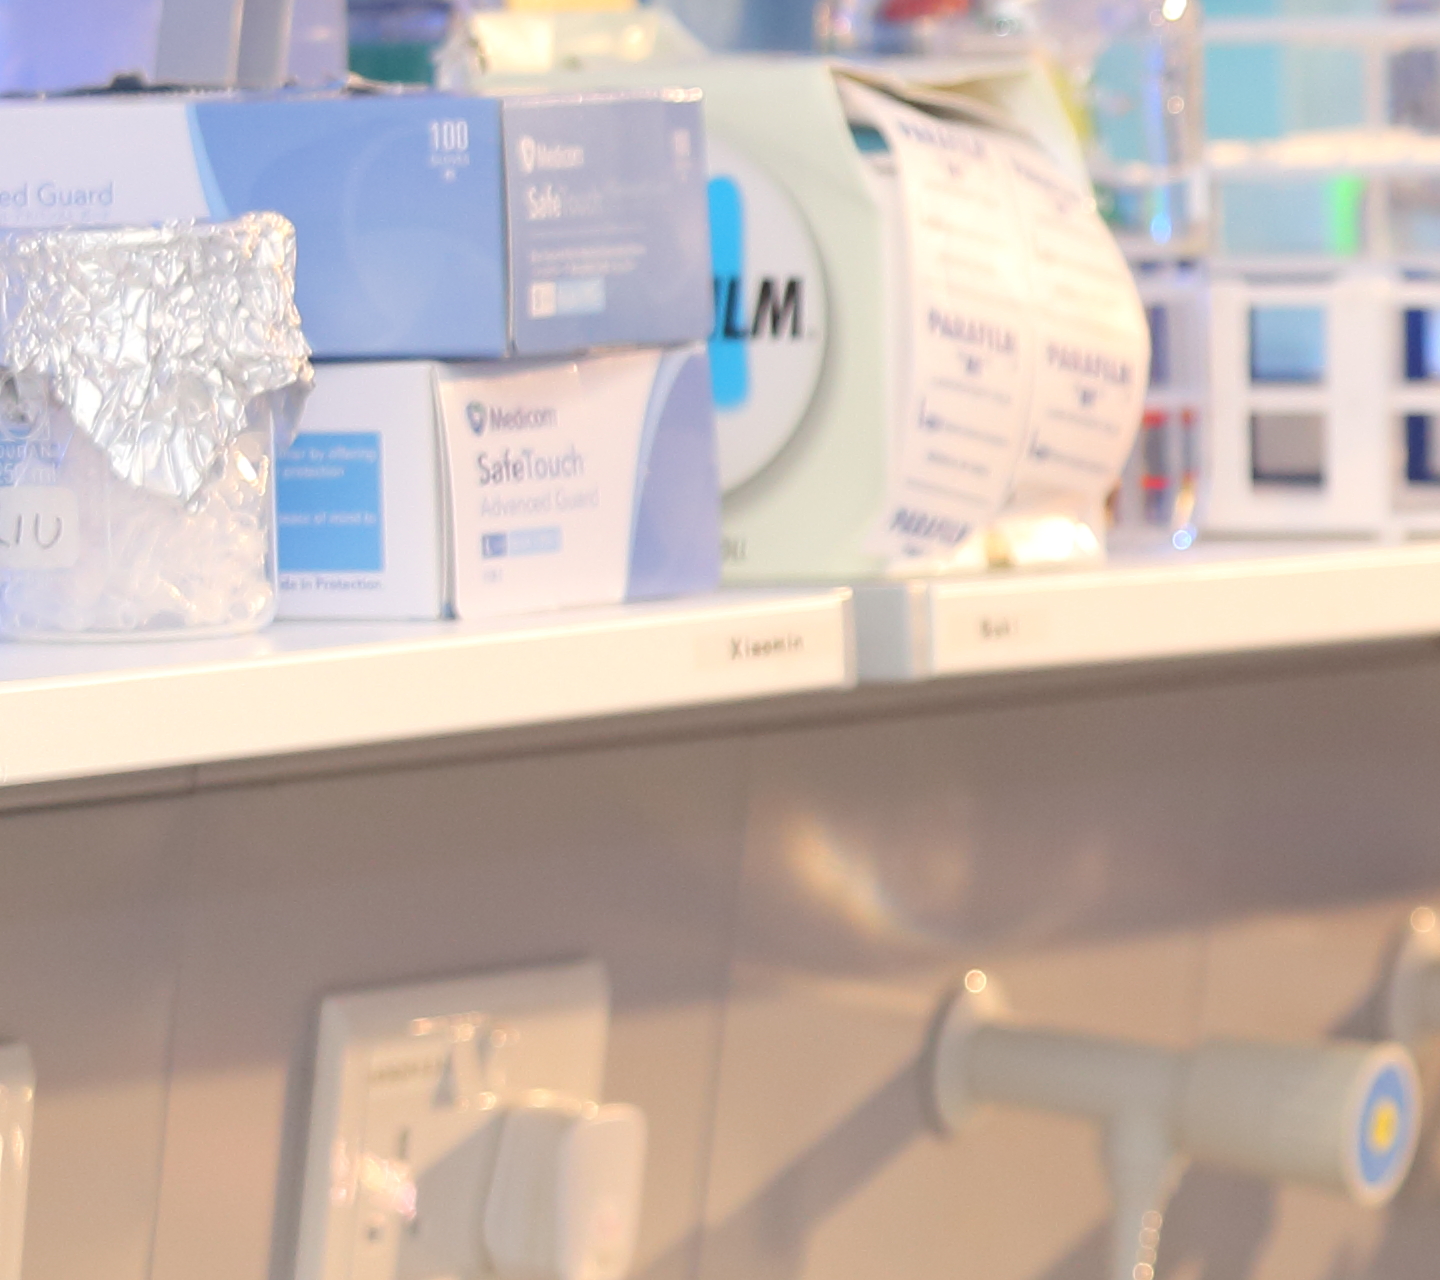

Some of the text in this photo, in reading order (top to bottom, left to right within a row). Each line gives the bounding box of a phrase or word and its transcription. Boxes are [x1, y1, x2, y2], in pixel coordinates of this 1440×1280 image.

[430, 120, 469, 152] 100
[37, 182, 114, 207] Guard
[490, 406, 558, 431] Medicom
[477, 443, 584, 486] SafeTouch
[0, 513, 62, 550] IU
[731, 633, 803, 660] Xiaomin
